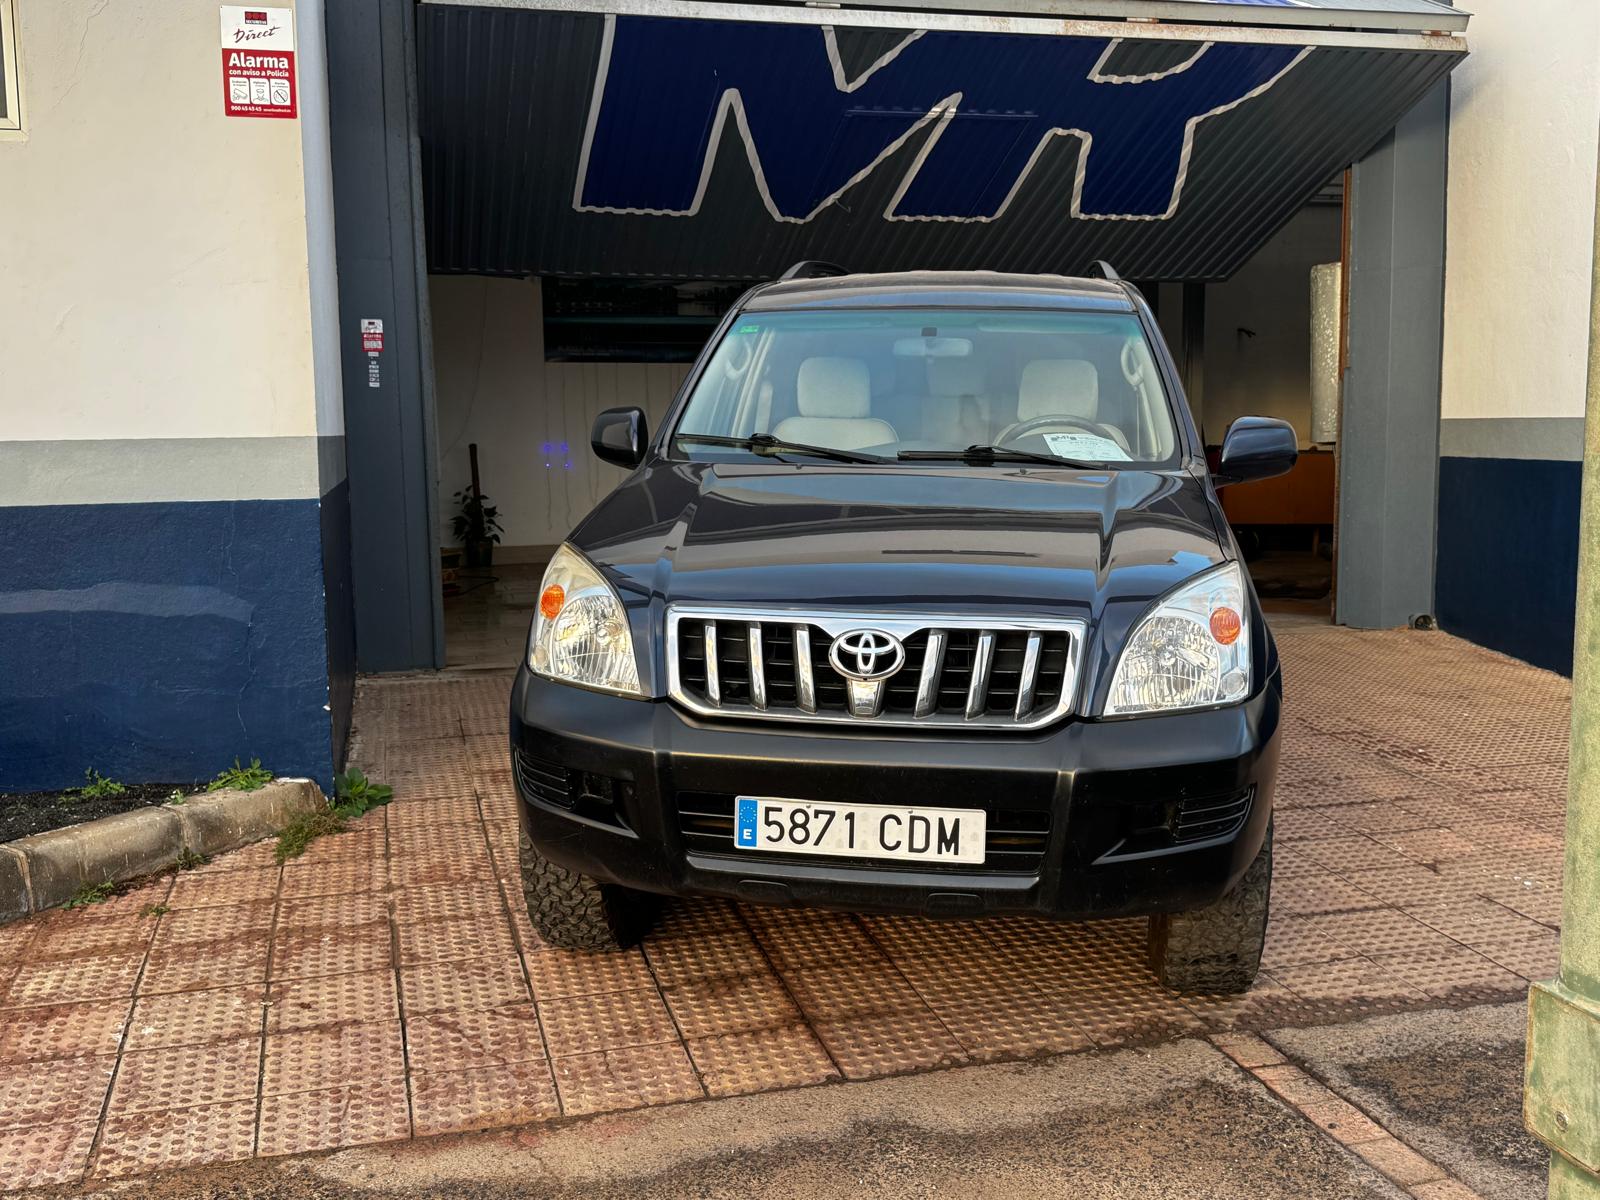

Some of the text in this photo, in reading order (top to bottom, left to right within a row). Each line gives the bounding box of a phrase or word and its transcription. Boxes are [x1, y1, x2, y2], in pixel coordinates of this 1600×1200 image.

[233, 26, 280, 43] Direct
[229, 52, 288, 69] Alarma
[243, 68, 260, 76] aviso
[743, 829, 752, 840] E
[764, 806, 961, 856] 5871 CDM
